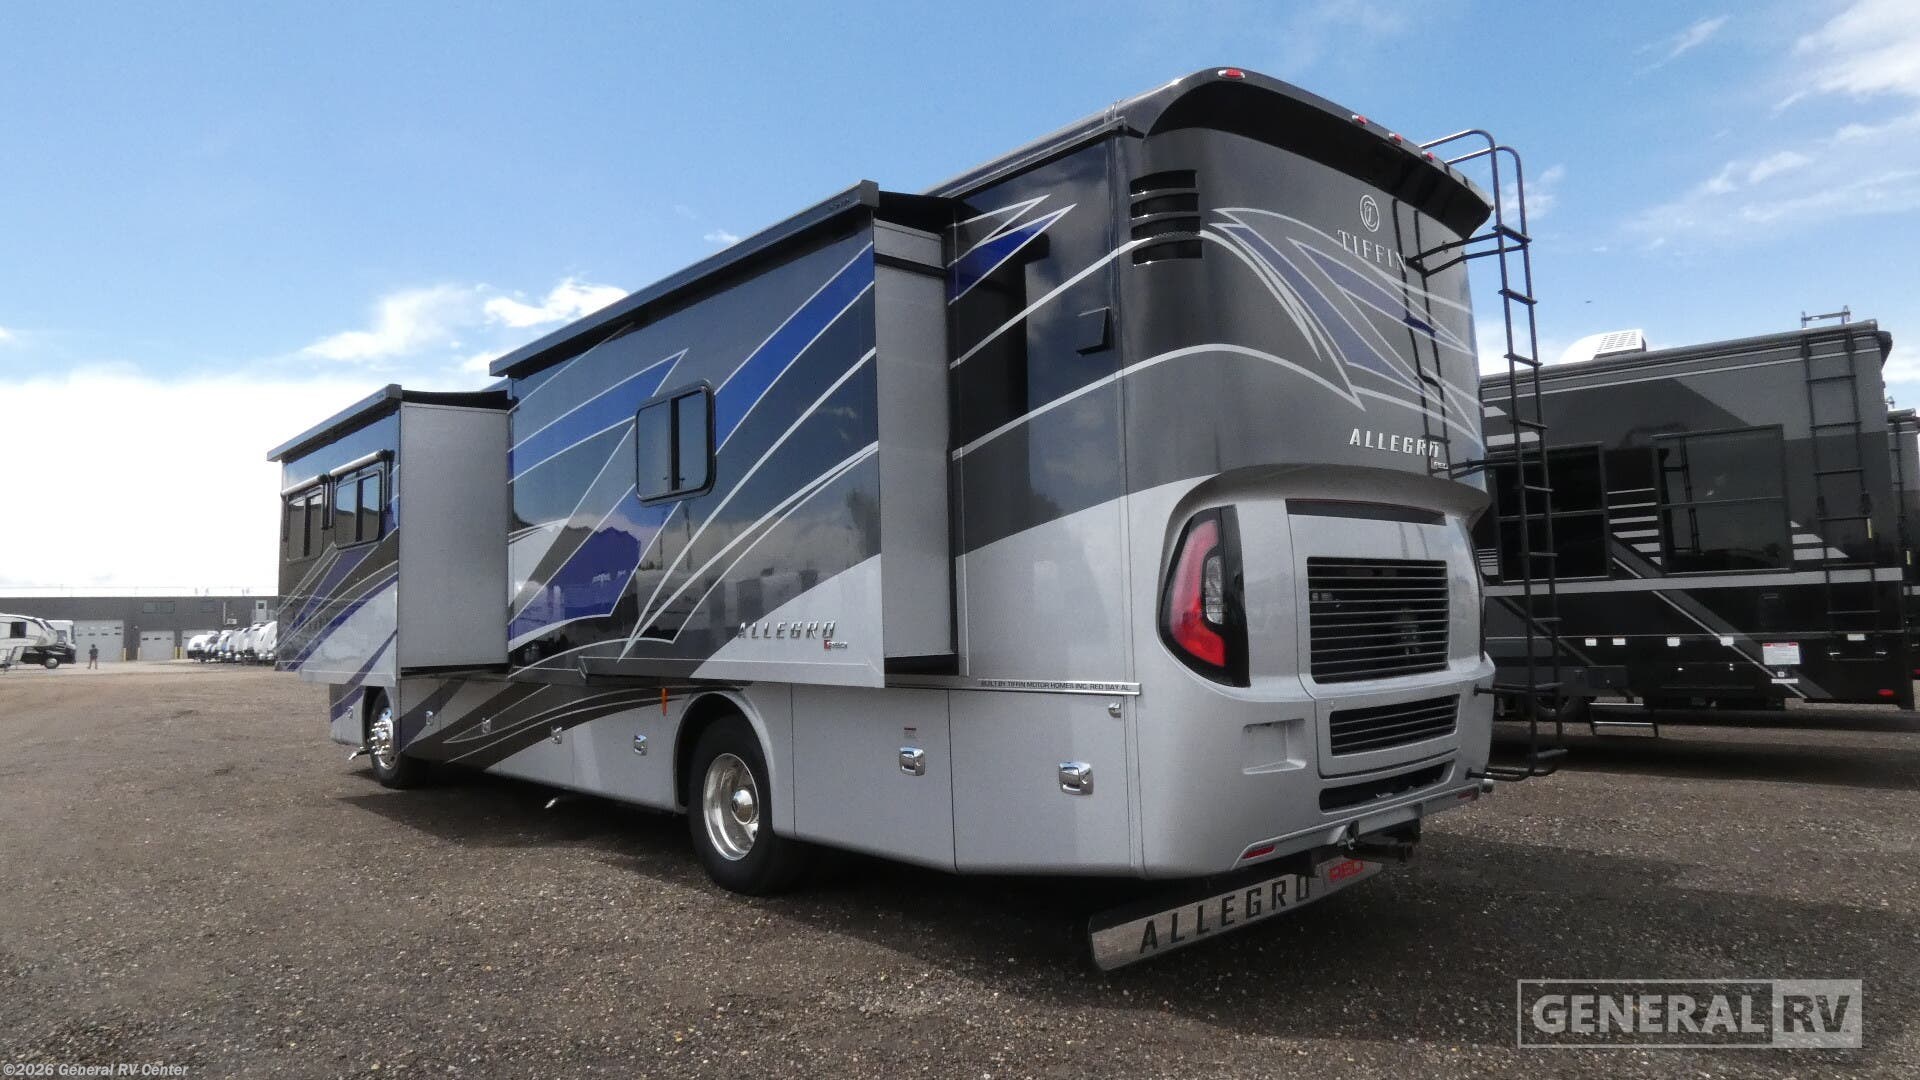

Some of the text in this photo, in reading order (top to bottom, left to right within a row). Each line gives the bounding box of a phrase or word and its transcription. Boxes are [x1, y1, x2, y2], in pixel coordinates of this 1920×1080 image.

[1337, 229, 1408, 273] TIFFIN
[1349, 428, 1440, 458] ALLEGRO
[738, 620, 837, 640] ALLEGRO
[1007, 681, 1026, 689] TIFFIN
[1027, 682, 1050, 690] MOTOR
[1050, 682, 1074, 690] HOMES
[1090, 683, 1105, 691] RED
[1140, 874, 1310, 954] ALLEGRO
